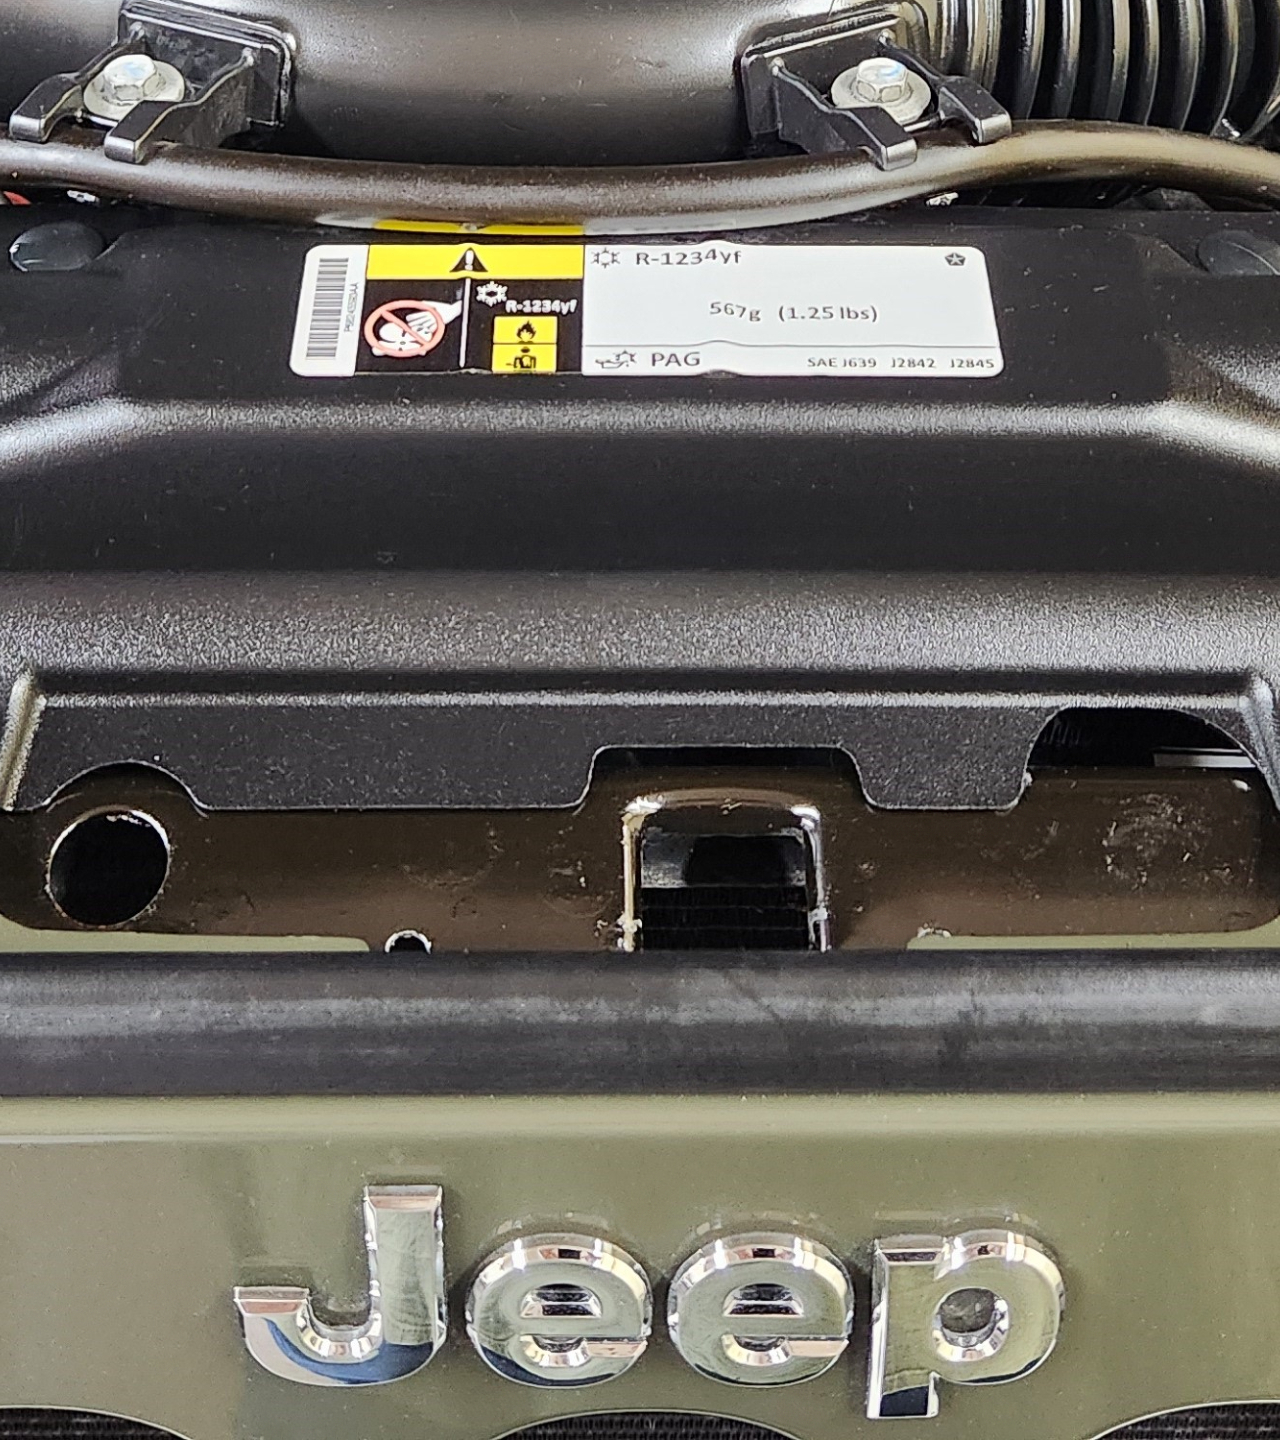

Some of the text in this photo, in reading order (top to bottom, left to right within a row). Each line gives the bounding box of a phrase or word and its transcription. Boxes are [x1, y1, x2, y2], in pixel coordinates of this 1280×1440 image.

[636, 249, 742, 265] R-1234yf
[505, 300, 578, 315] R-1234yf
[710, 301, 878, 322] 567g (1.25 lbs)
[651, 352, 701, 367] PAG
[807, 357, 995, 368] SAE J639 J2842 J2845
[234, 1185, 1067, 1420] Jeep
